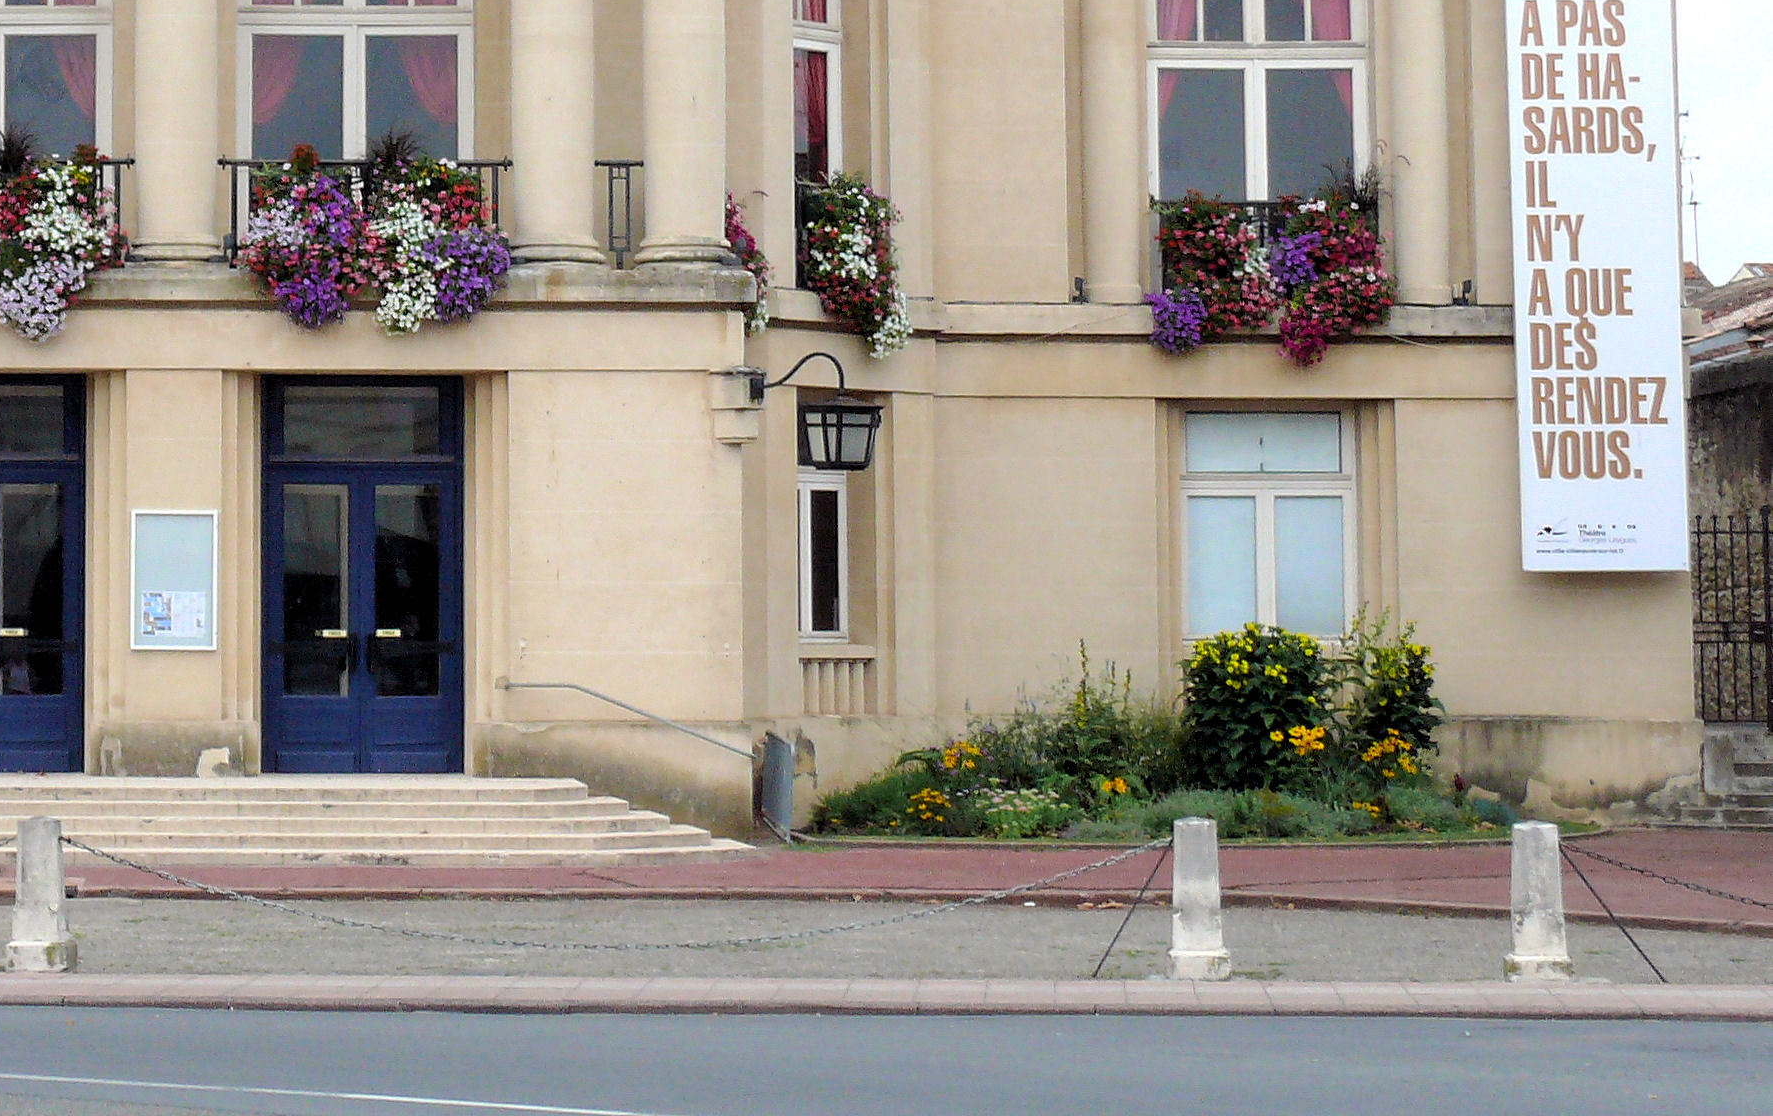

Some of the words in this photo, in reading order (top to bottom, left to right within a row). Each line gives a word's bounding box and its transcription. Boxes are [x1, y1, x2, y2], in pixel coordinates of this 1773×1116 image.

[1520, 0, 1544, 46] A
[1556, 0, 1625, 47] PAS
[1521, 53, 1564, 100] DE
[1578, 53, 1640, 100] HA-
[1523, 106, 1656, 162] SARDS,
[1525, 161, 1557, 208] IL
[1526, 214, 1584, 262] N'Y
[1528, 268, 1552, 316] A
[1565, 268, 1633, 326] QUE
[1529, 322, 1598, 371] DES
[1531, 377, 1668, 425] RENDEZ
[1532, 430, 1643, 480] VOUS.
